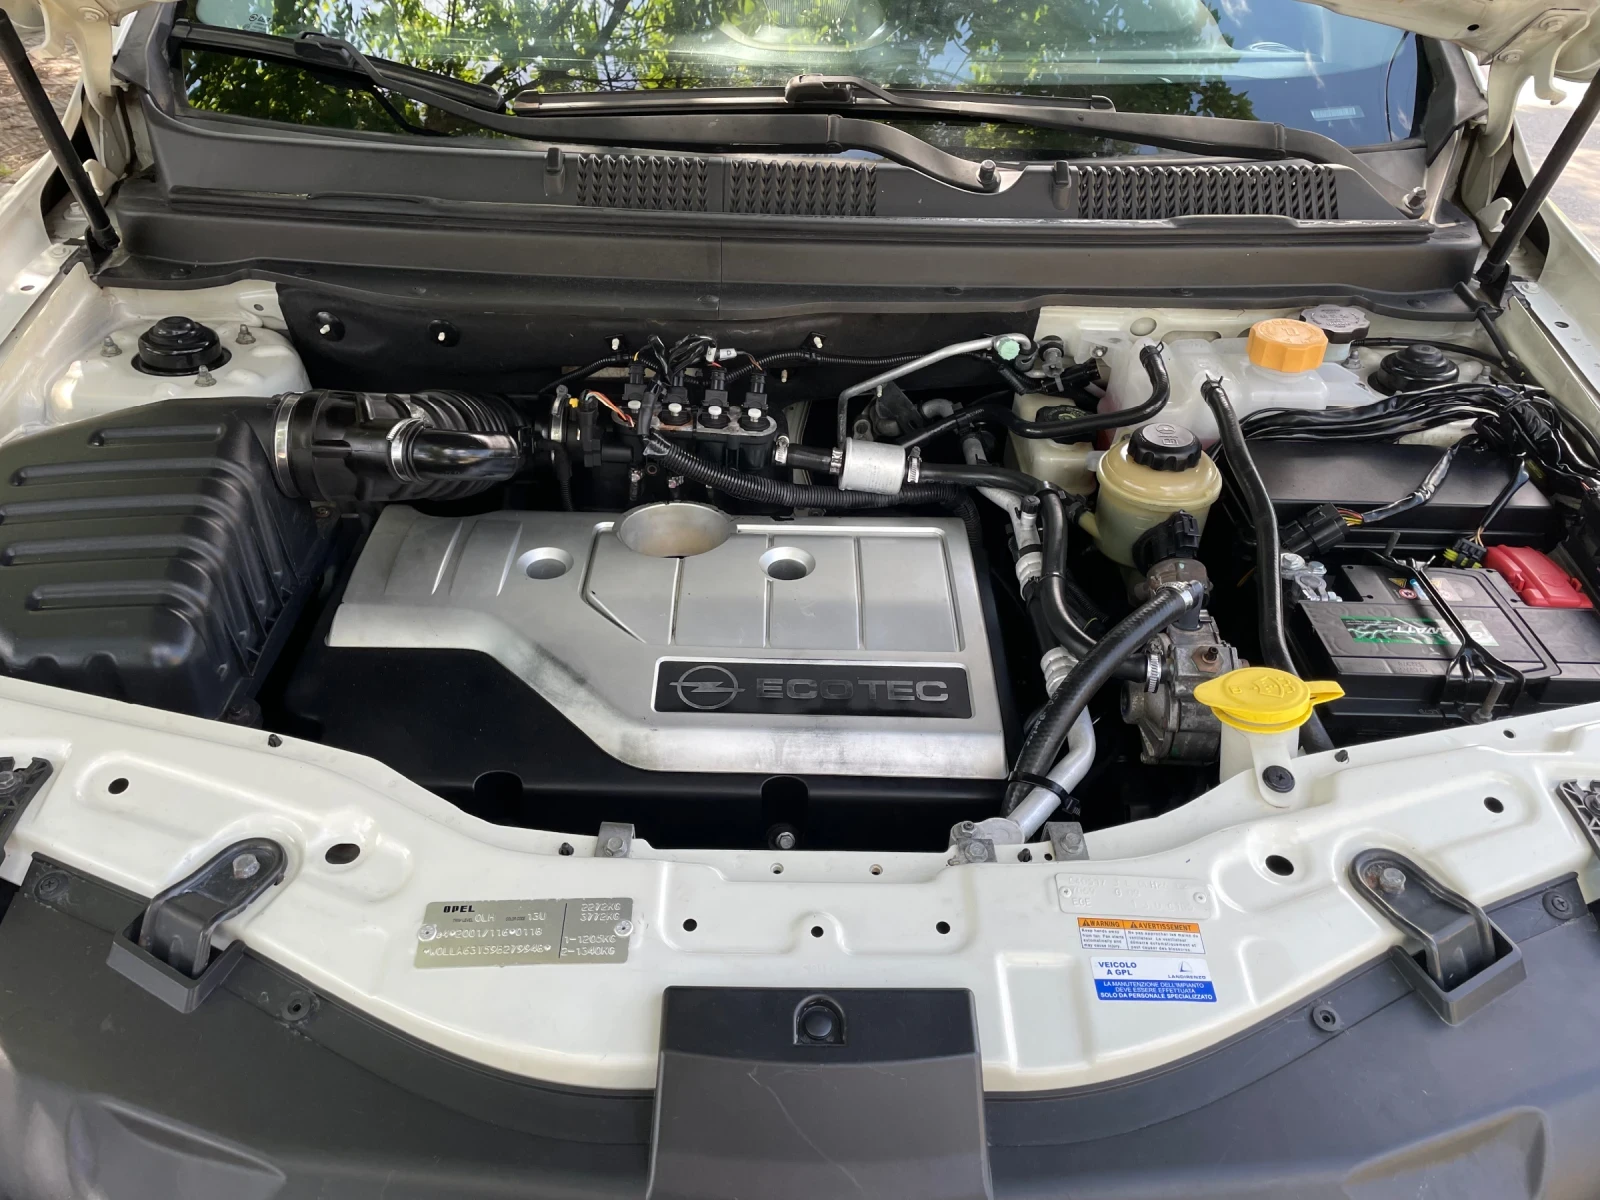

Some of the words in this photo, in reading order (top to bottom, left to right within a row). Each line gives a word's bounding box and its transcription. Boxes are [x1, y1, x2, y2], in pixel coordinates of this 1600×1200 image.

[1392, 625, 1482, 639] GAWATT
[756, 678, 949, 702] ECOTEC
[444, 904, 476, 913] OPEL
[528, 912, 547, 921] 13U
[1138, 922, 1192, 931] AVERTISSEMENT
